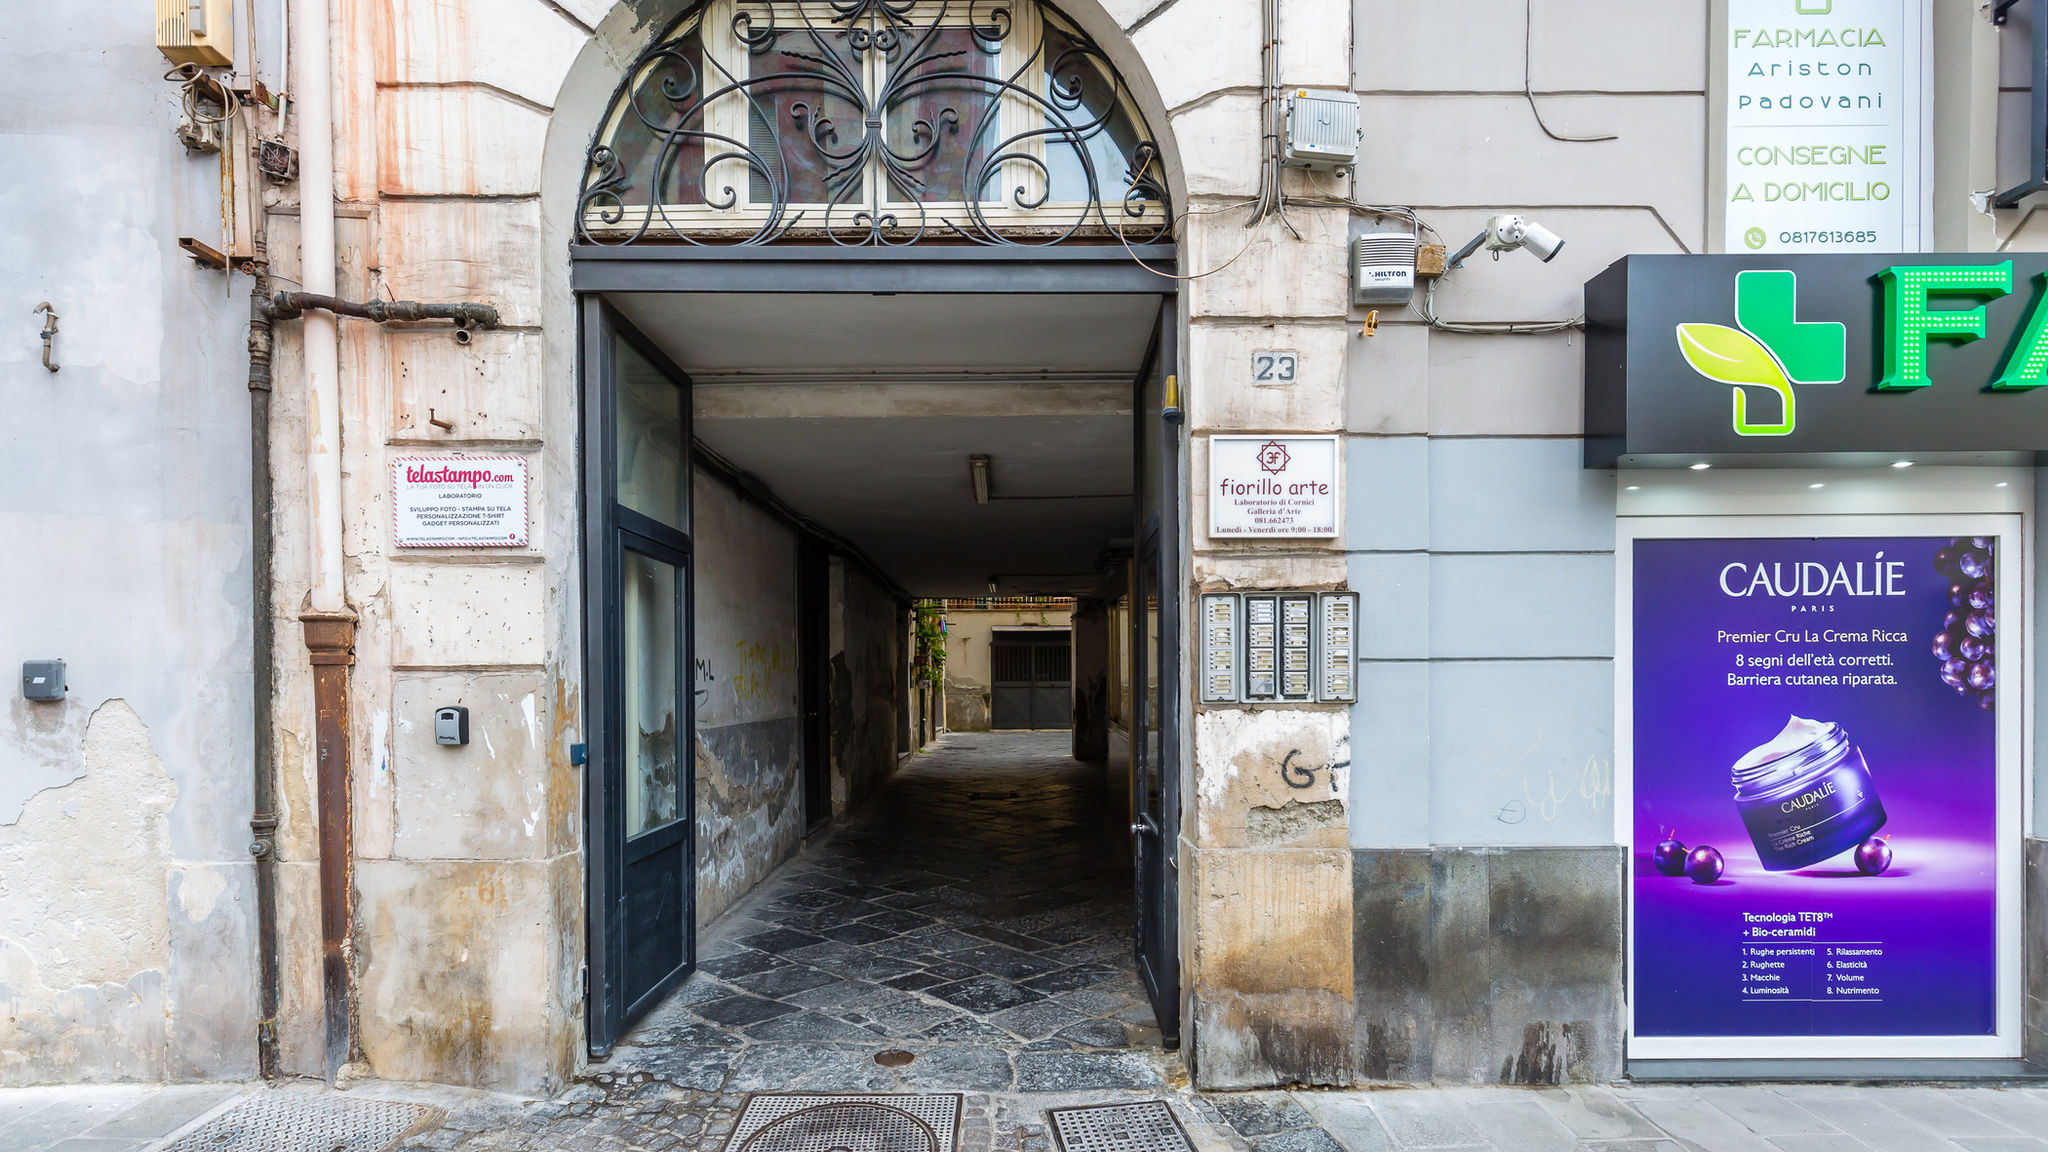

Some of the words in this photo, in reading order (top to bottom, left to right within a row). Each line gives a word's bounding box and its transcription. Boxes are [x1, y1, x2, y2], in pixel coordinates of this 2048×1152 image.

[1734, 28, 1886, 48] FARMACIA
[1747, 60, 1872, 77] Ariston
[1738, 92, 1883, 110] Padovani
[1737, 145, 1886, 165] CONSEGNE
[1731, 183, 1754, 202] A
[1764, 181, 1890, 202] DOMICILIO
[1779, 230, 1877, 244] 0817613685
[1257, 356, 1295, 381] 23
[406, 464, 514, 489] telastampo.com
[1220, 478, 1282, 496] fiorillo
[1289, 480, 1329, 495] arte
[1717, 630, 1771, 643] Premier
[1775, 630, 1800, 643] Cru
[1804, 630, 1819, 643] La
[1823, 630, 1868, 643] Crema
[1872, 630, 1908, 643] Ricca
[1736, 654, 1744, 666] 8
[1748, 654, 1783, 669] segni
[1838, 653, 1894, 666] corretti.
[1727, 673, 1781, 686] Barriera
[1785, 674, 1838, 686] cutanea
[1842, 673, 1897, 687] riparata.
[1742, 912, 1796, 923] Tecnologia
[1752, 927, 1816, 936] Bio-ceramidi
[1750, 948, 1774, 957] Rughe
[1776, 948, 1815, 957] persistenti
[1750, 962, 1785, 970] Rughette
